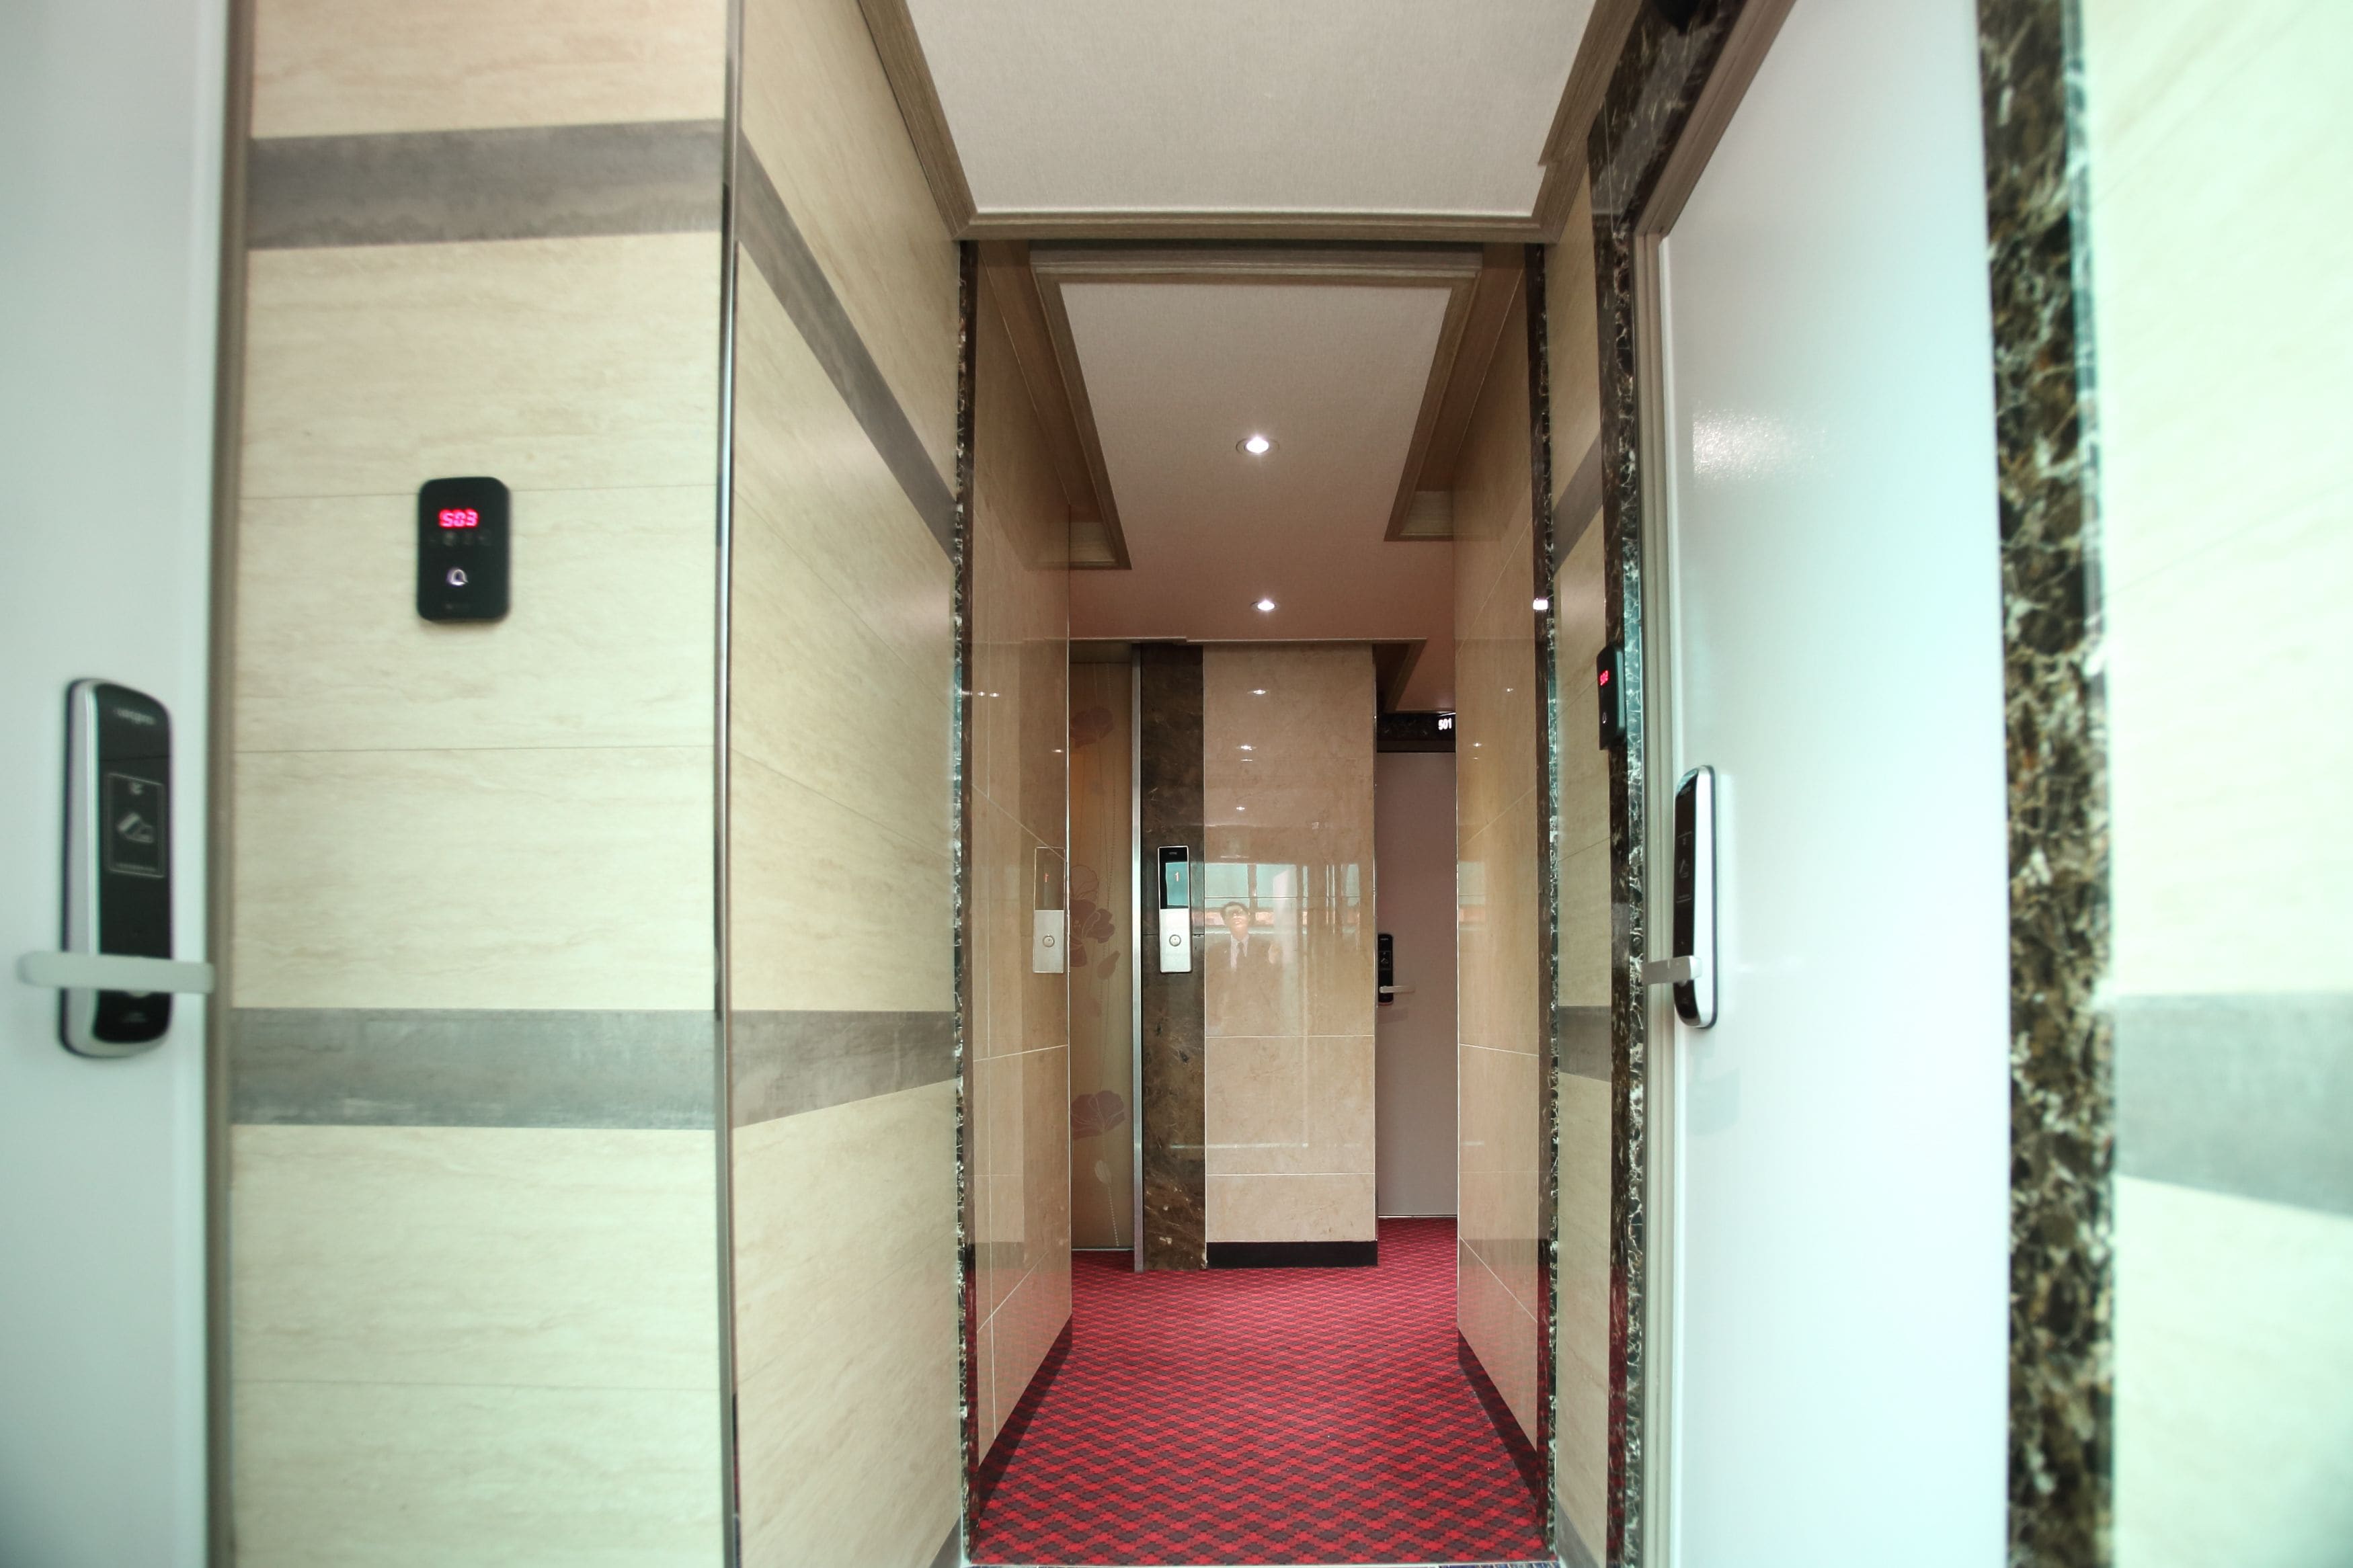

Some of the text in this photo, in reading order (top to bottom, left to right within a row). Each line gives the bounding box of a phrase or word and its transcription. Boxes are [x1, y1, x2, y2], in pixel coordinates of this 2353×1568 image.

[439, 507, 479, 529] 503
[1438, 717, 1452, 731] 501
[1174, 872, 1179, 882] 1
